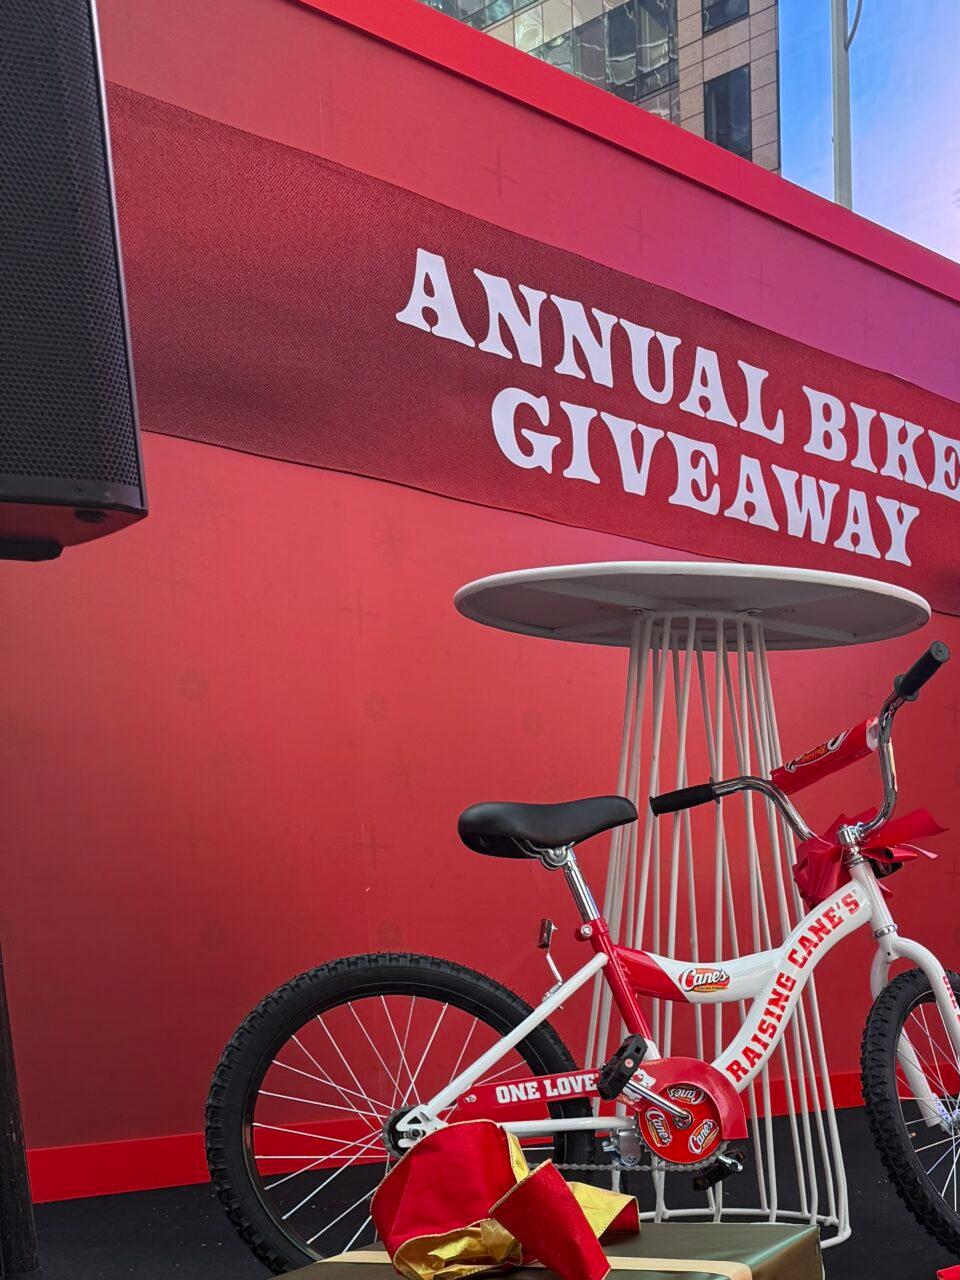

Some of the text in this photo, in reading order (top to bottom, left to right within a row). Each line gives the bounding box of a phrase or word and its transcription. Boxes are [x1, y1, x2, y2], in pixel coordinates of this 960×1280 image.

[396, 248, 784, 444] ANNUAL
[490, 387, 920, 567] GIVEAWAY
[788, 892, 861, 970] CANE'S
[680, 967, 730, 993] Cane's
[725, 972, 797, 1084] RAISING
[496, 1073, 597, 1104] ONE LOVE
